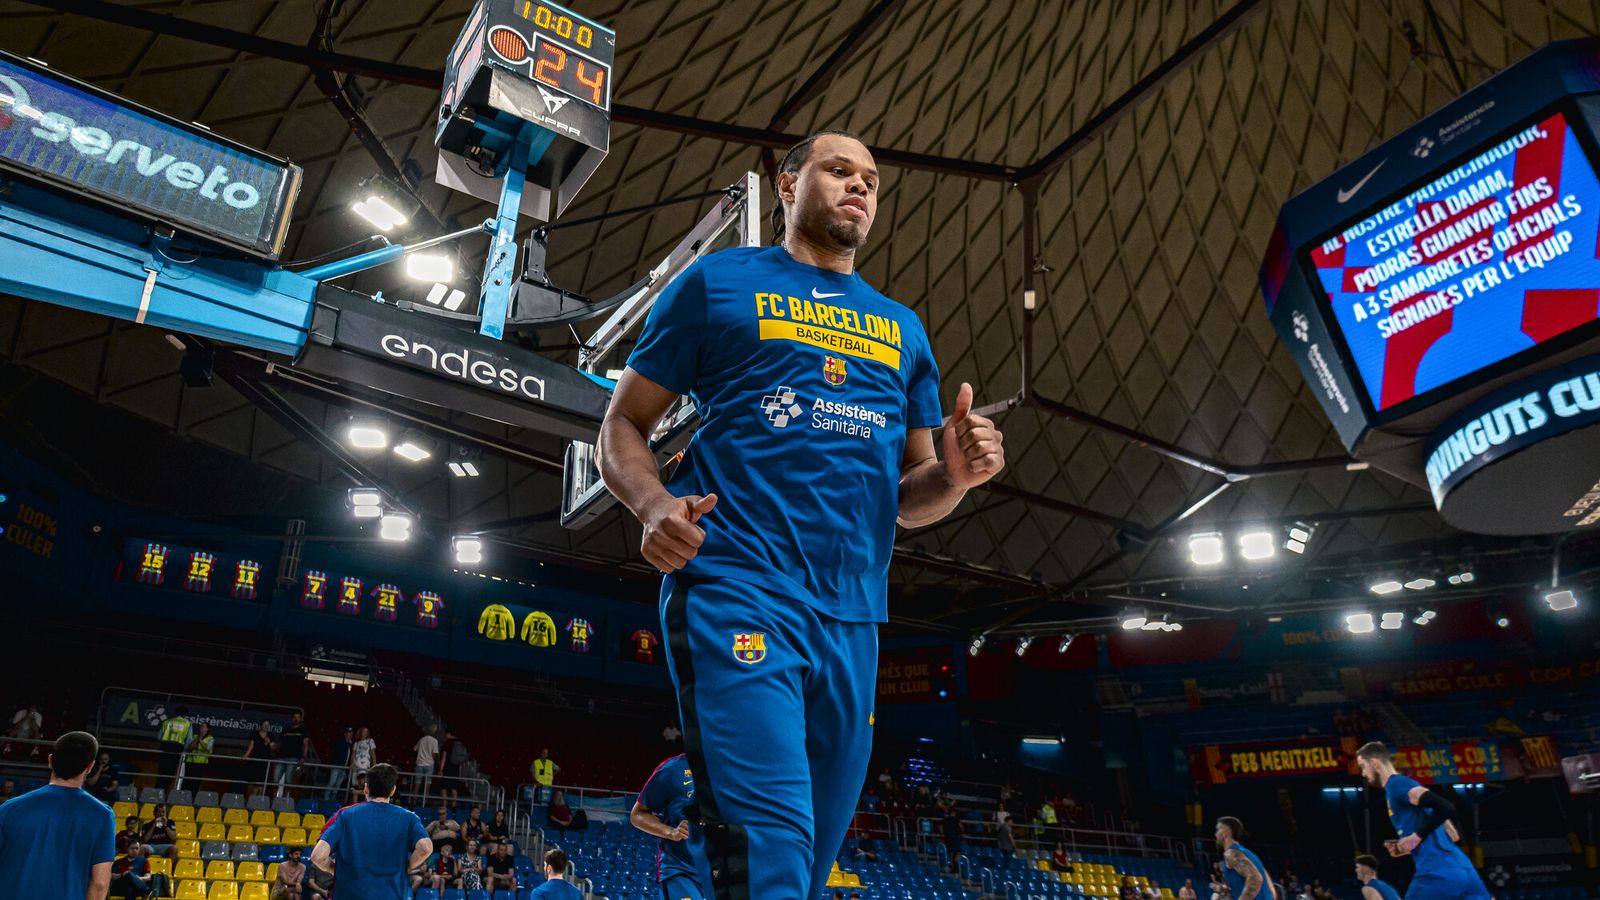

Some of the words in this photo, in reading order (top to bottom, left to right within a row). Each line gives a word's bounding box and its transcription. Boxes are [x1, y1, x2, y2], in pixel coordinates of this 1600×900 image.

[522, 0, 593, 49] 10:00
[535, 41, 604, 105] 24
[520, 107, 581, 137] CUPRA
[31, 111, 260, 210] serveto
[1366, 202, 1448, 257] ESTRELLA
[1444, 169, 1515, 216] DAMM.
[1420, 201, 1507, 258] GUANYAR
[1505, 176, 1554, 214] FINS
[1352, 302, 1368, 322] A
[1364, 295, 1381, 315] 3
[1379, 238, 1494, 308] SAMARRETES
[1492, 194, 1582, 251] OFICIALS
[1377, 284, 1464, 338] SIGNADES
[1461, 266, 1502, 298] PER
[1499, 230, 1573, 280] L'EQUIP
[755, 292, 786, 318] FC
[787, 296, 902, 349] BARCELONA
[796, 327, 874, 355] BASKETBALL
[380, 334, 545, 401] endesa
[811, 412, 872, 439] Sanitària
[812, 398, 887, 428] Assistència
[143, 553, 164, 569] 15
[190, 561, 210, 577] 12
[238, 569, 254, 585] 11
[309, 580, 321, 593] 7
[344, 587, 355, 600] 4
[378, 592, 395, 607] 21
[423, 600, 434, 613] 9
[494, 613, 501, 625] 1
[532, 620, 547, 632] 16
[640, 638, 649, 650] 8
[120, 702, 140, 725] A
[1260, 747, 1338, 771] MERITXELL
